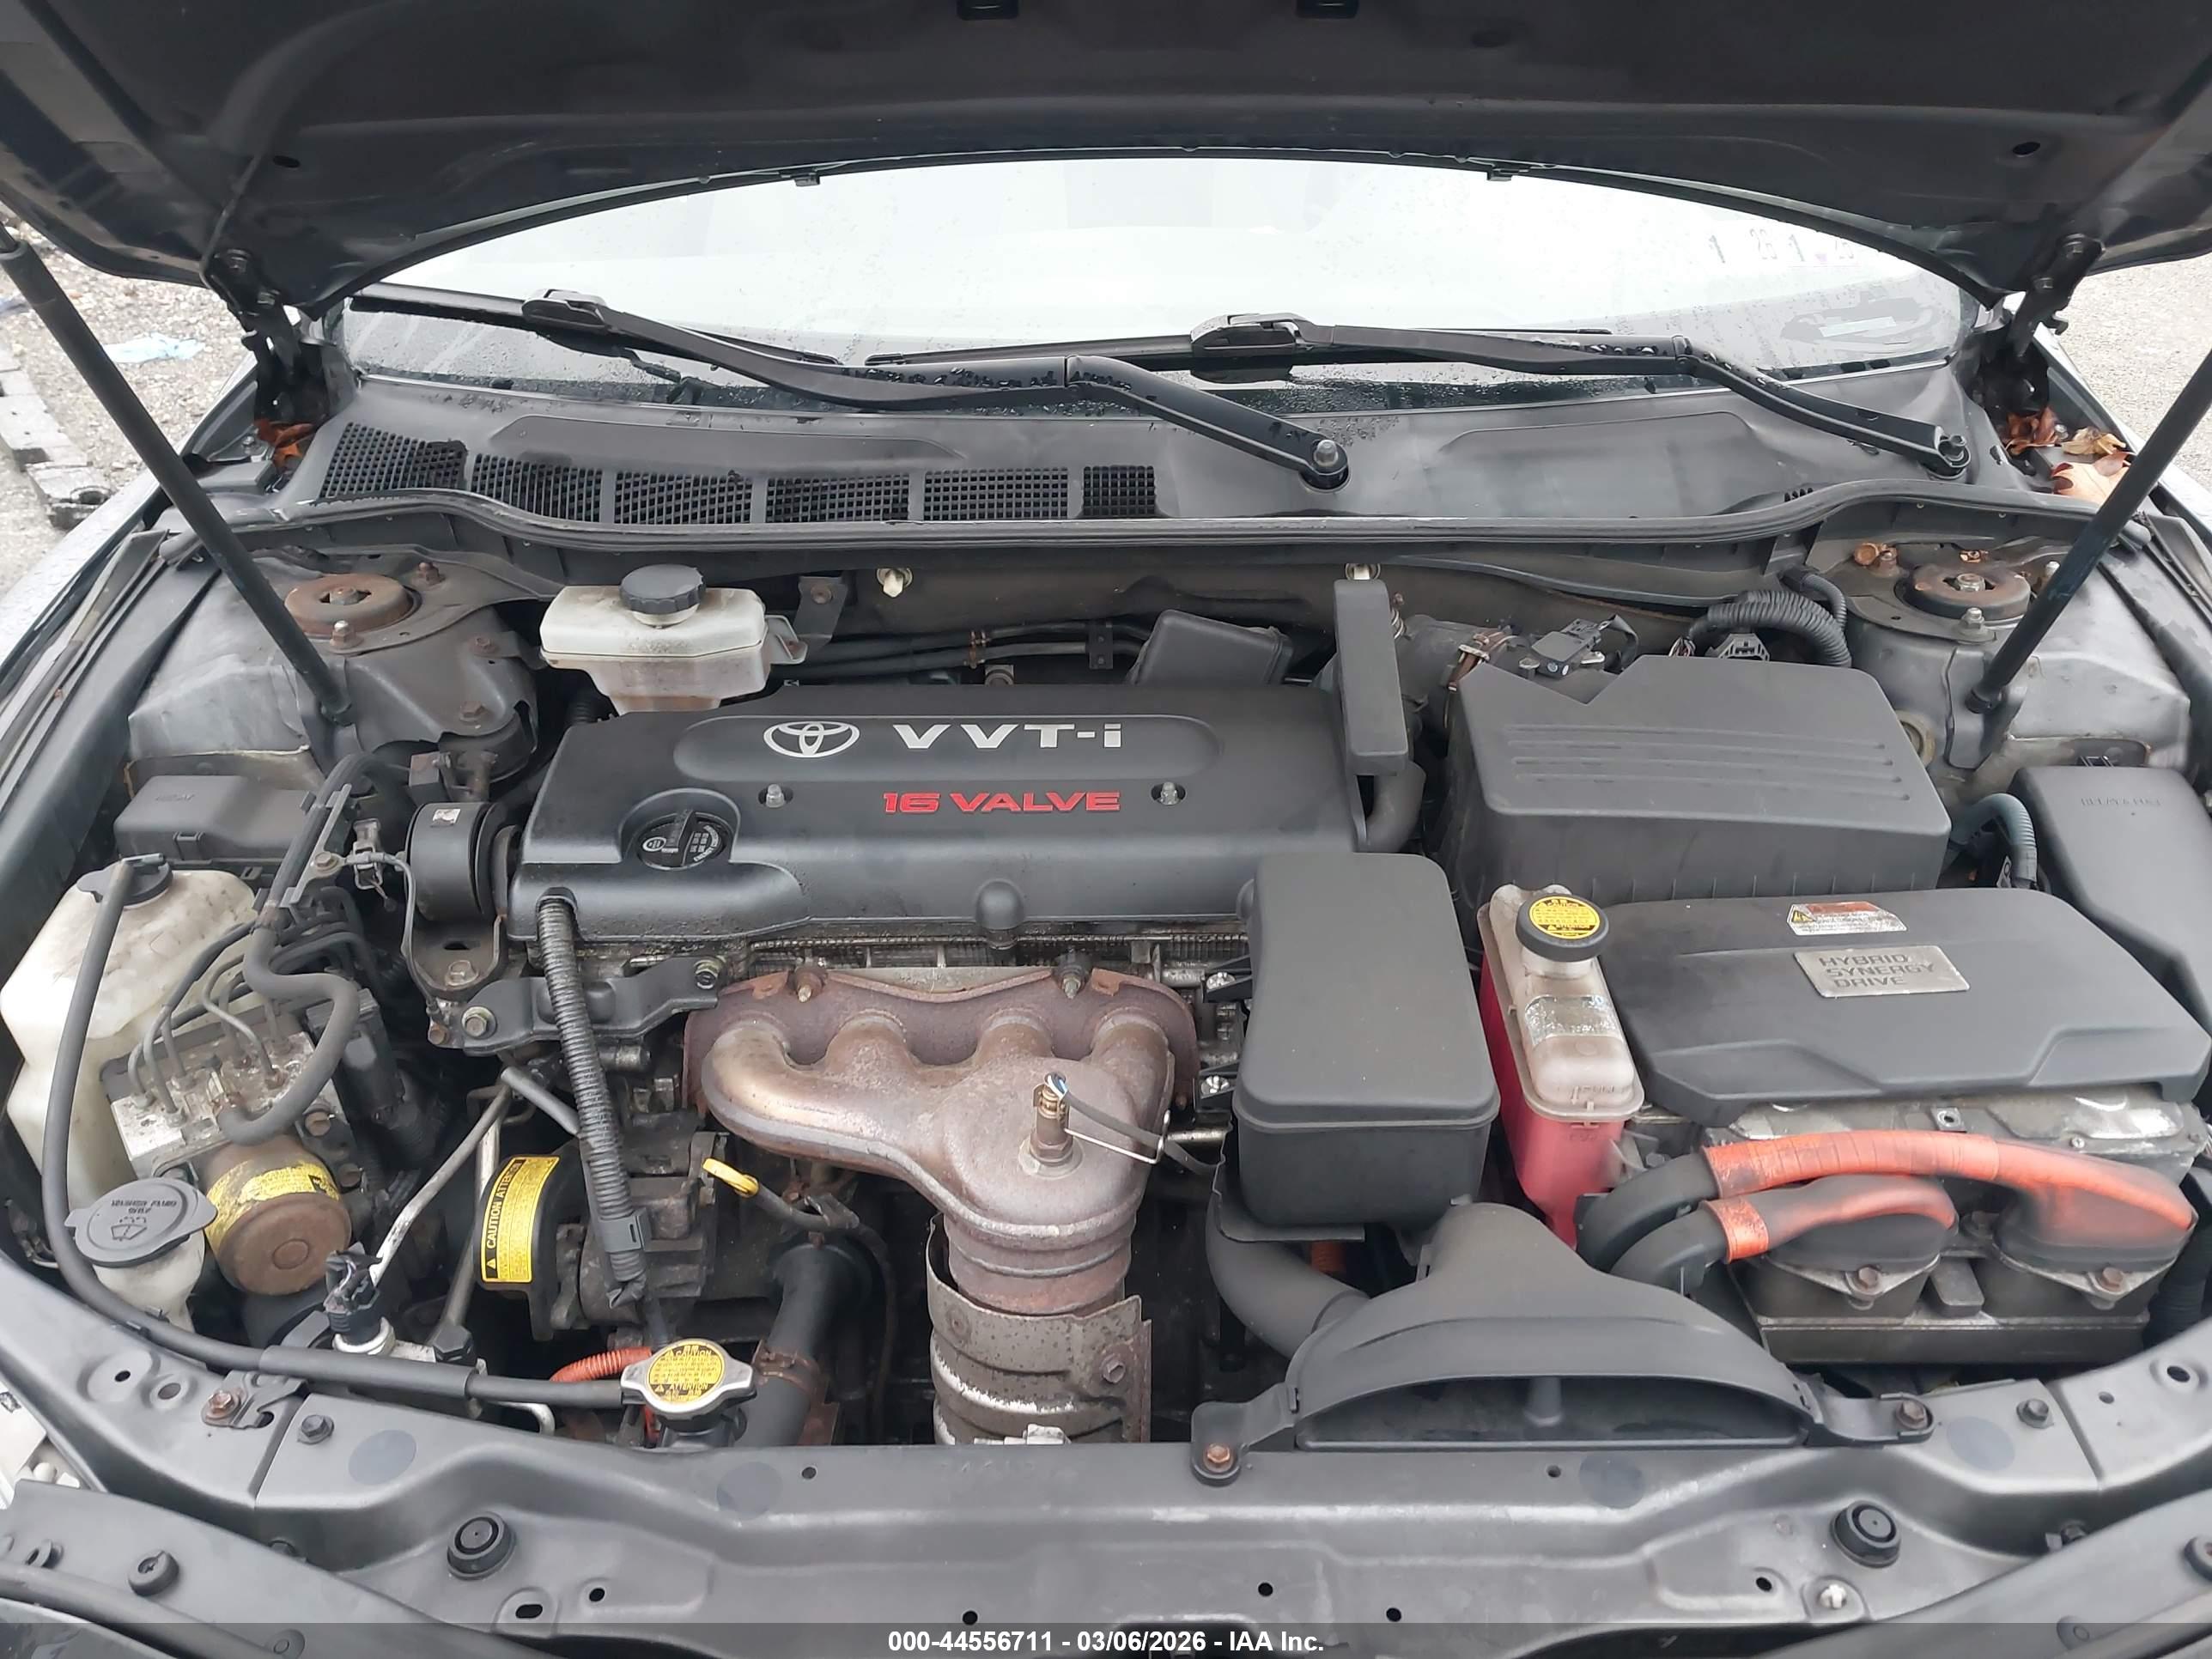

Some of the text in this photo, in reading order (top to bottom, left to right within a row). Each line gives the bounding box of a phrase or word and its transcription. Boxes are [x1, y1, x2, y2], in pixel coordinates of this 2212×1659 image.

[892, 723, 1122, 749] VVT-i
[883, 792, 1121, 814] 16 VALVE
[1819, 955, 1910, 966] HYBRID
[1826, 964, 1934, 977] SYNERGY
[1834, 977, 1905, 988] DRIVE
[486, 1200, 501, 1249] CAUTION
